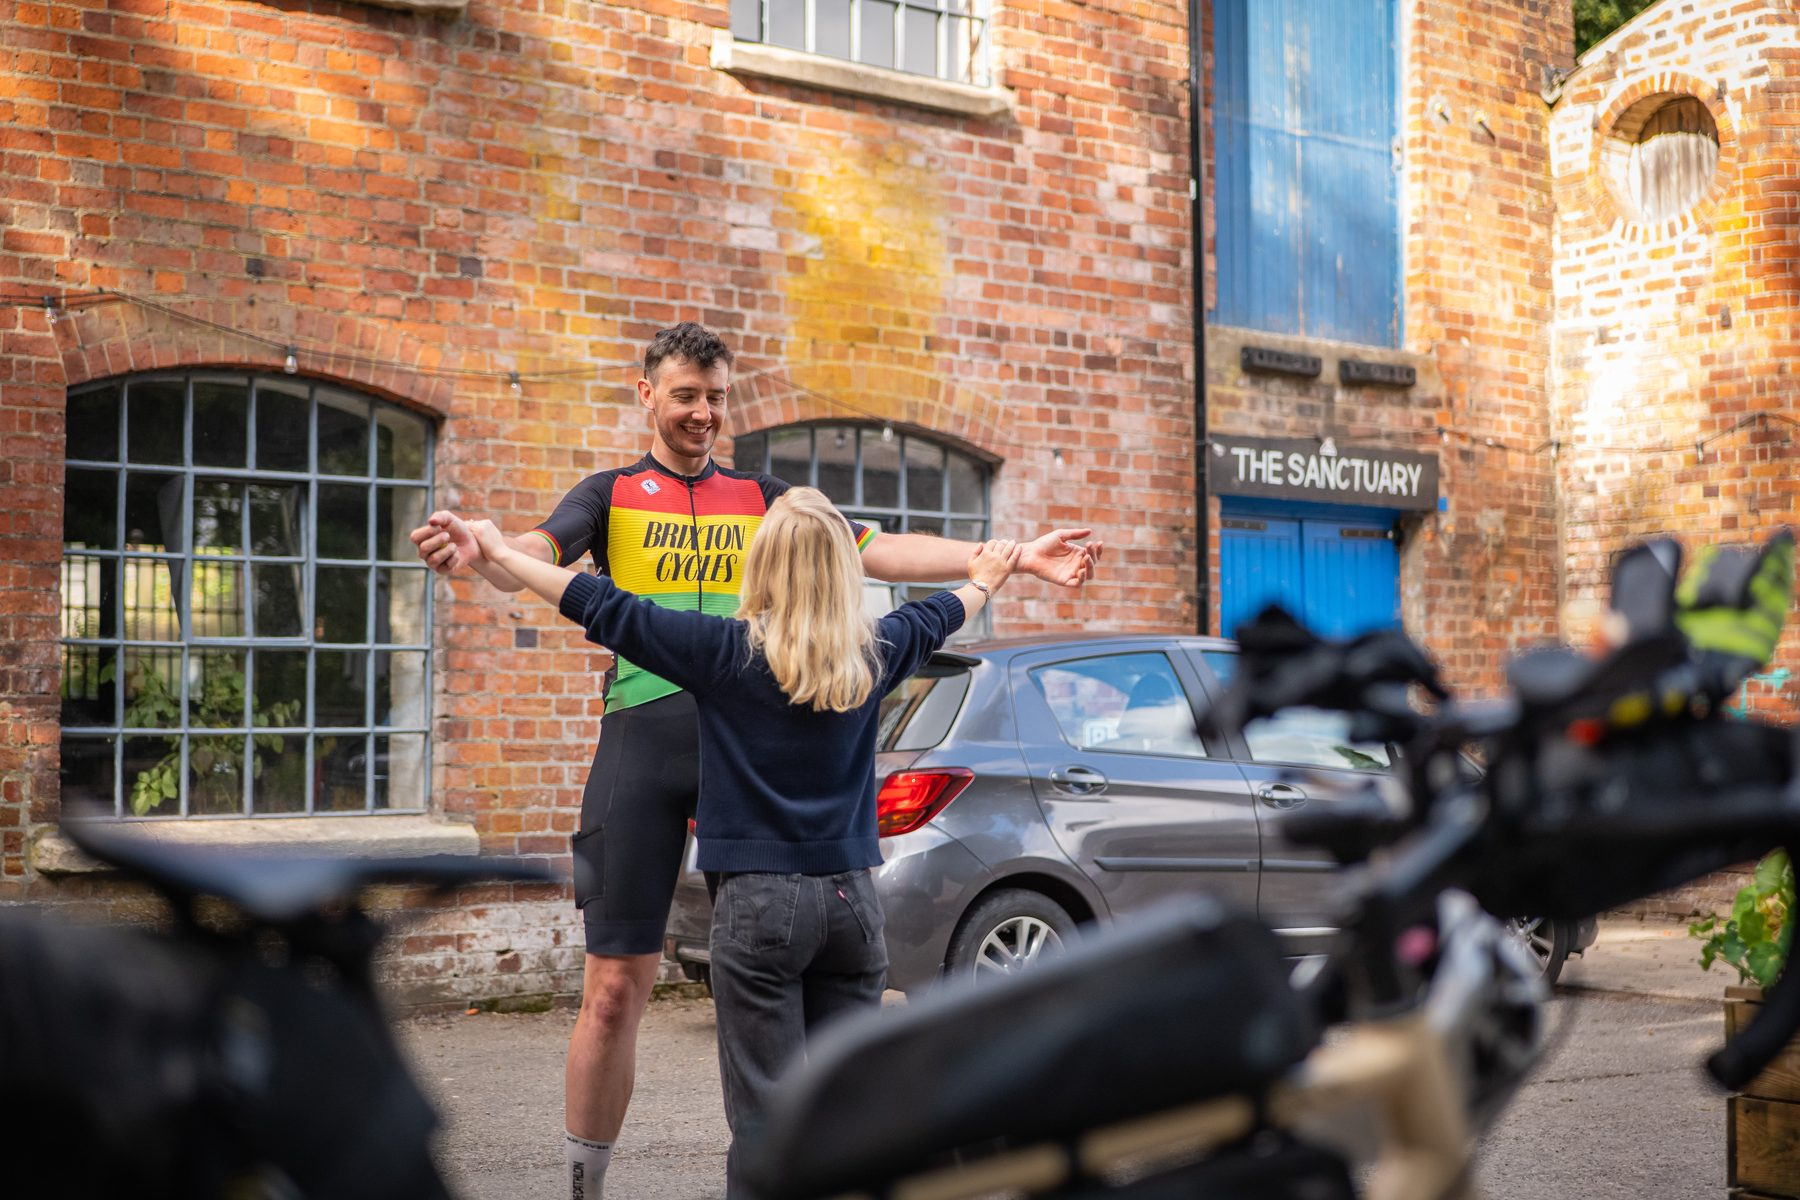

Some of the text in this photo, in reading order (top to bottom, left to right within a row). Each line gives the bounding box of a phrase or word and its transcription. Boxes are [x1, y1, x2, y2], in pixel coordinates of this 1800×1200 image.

[1231, 447, 1422, 496] THE SANCTUARY
[643, 521, 746, 551] BRIXTON
[656, 551, 738, 582] CYCLES
